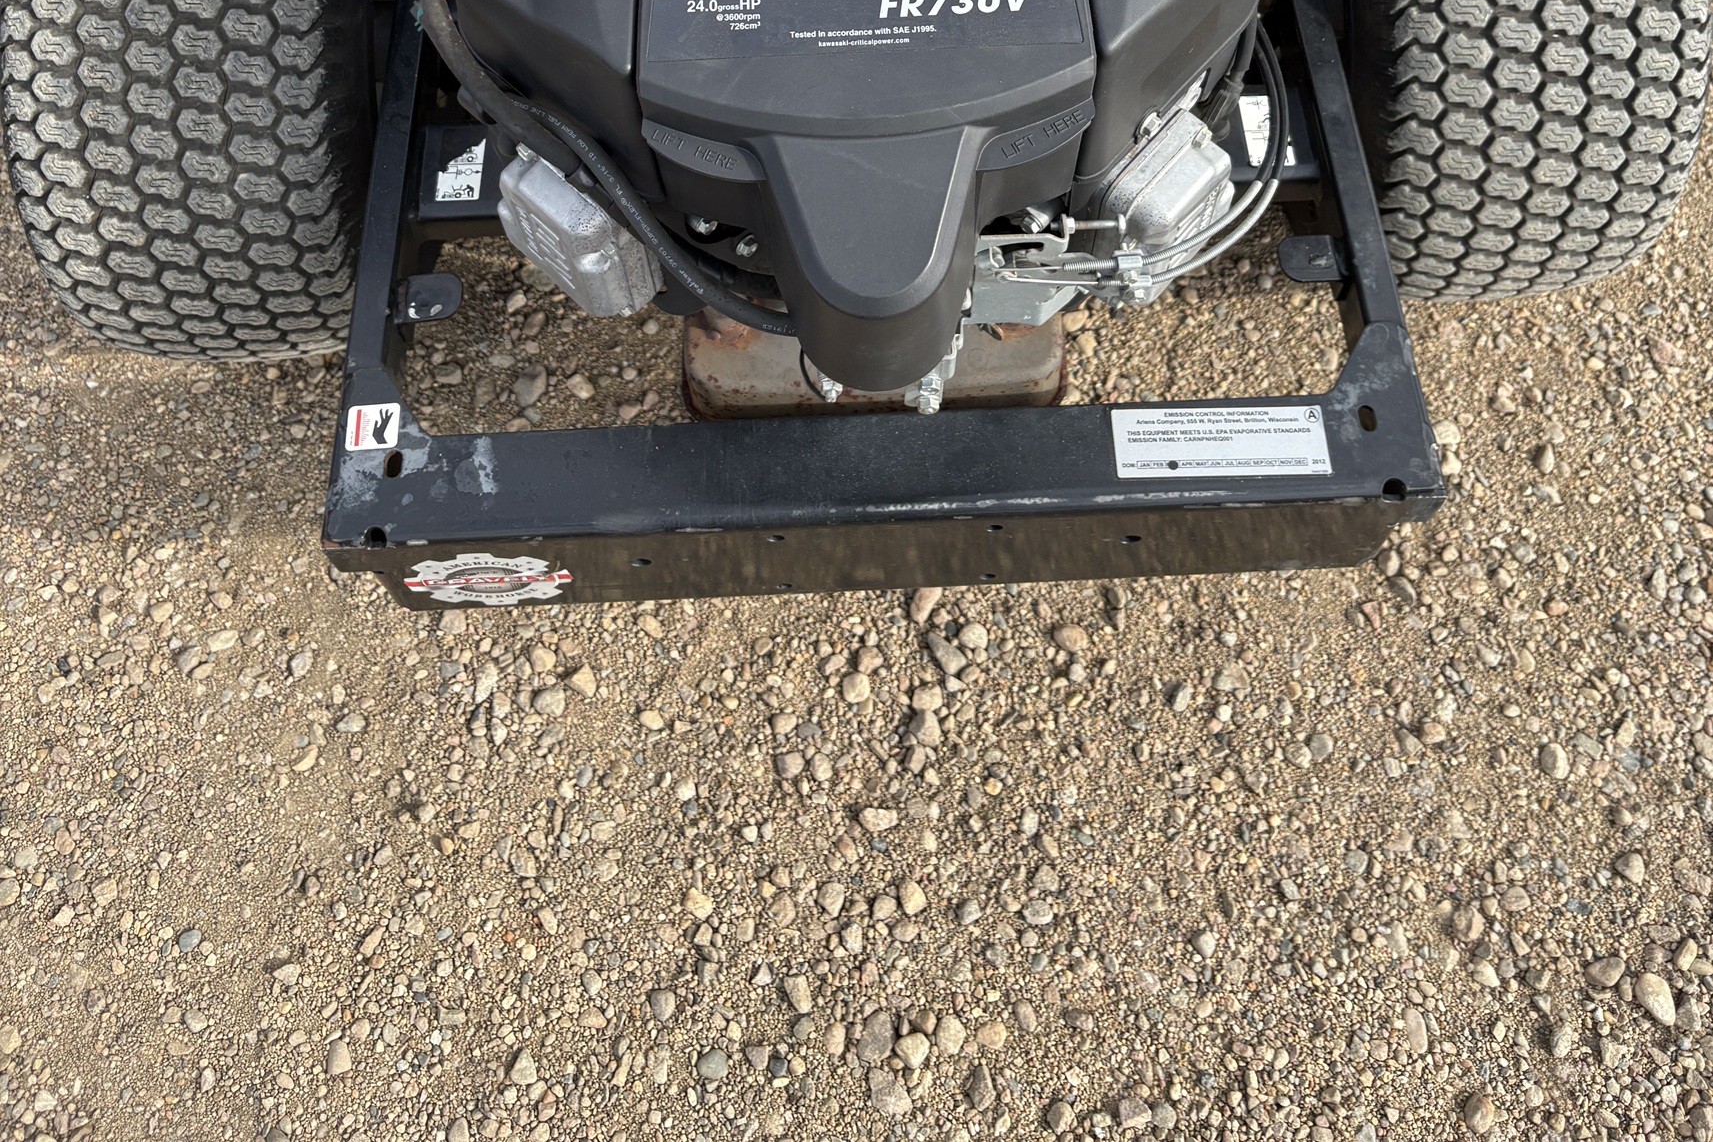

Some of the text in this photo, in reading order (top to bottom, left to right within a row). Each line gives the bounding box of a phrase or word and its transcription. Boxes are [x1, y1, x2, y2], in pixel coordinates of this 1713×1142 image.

[716, 12, 761, 23] @3600rpm
[790, 25, 937, 39] Tested in accordance with SAE J1995.
[818, 36, 910, 47] kawasaki-criticalpower.com
[1002, 108, 1086, 150] LIFT HERE
[652, 128, 739, 171] LIFT HERE
[1156, 418, 1186, 426] Company,
[443, 560, 524, 572] AMERICAN
